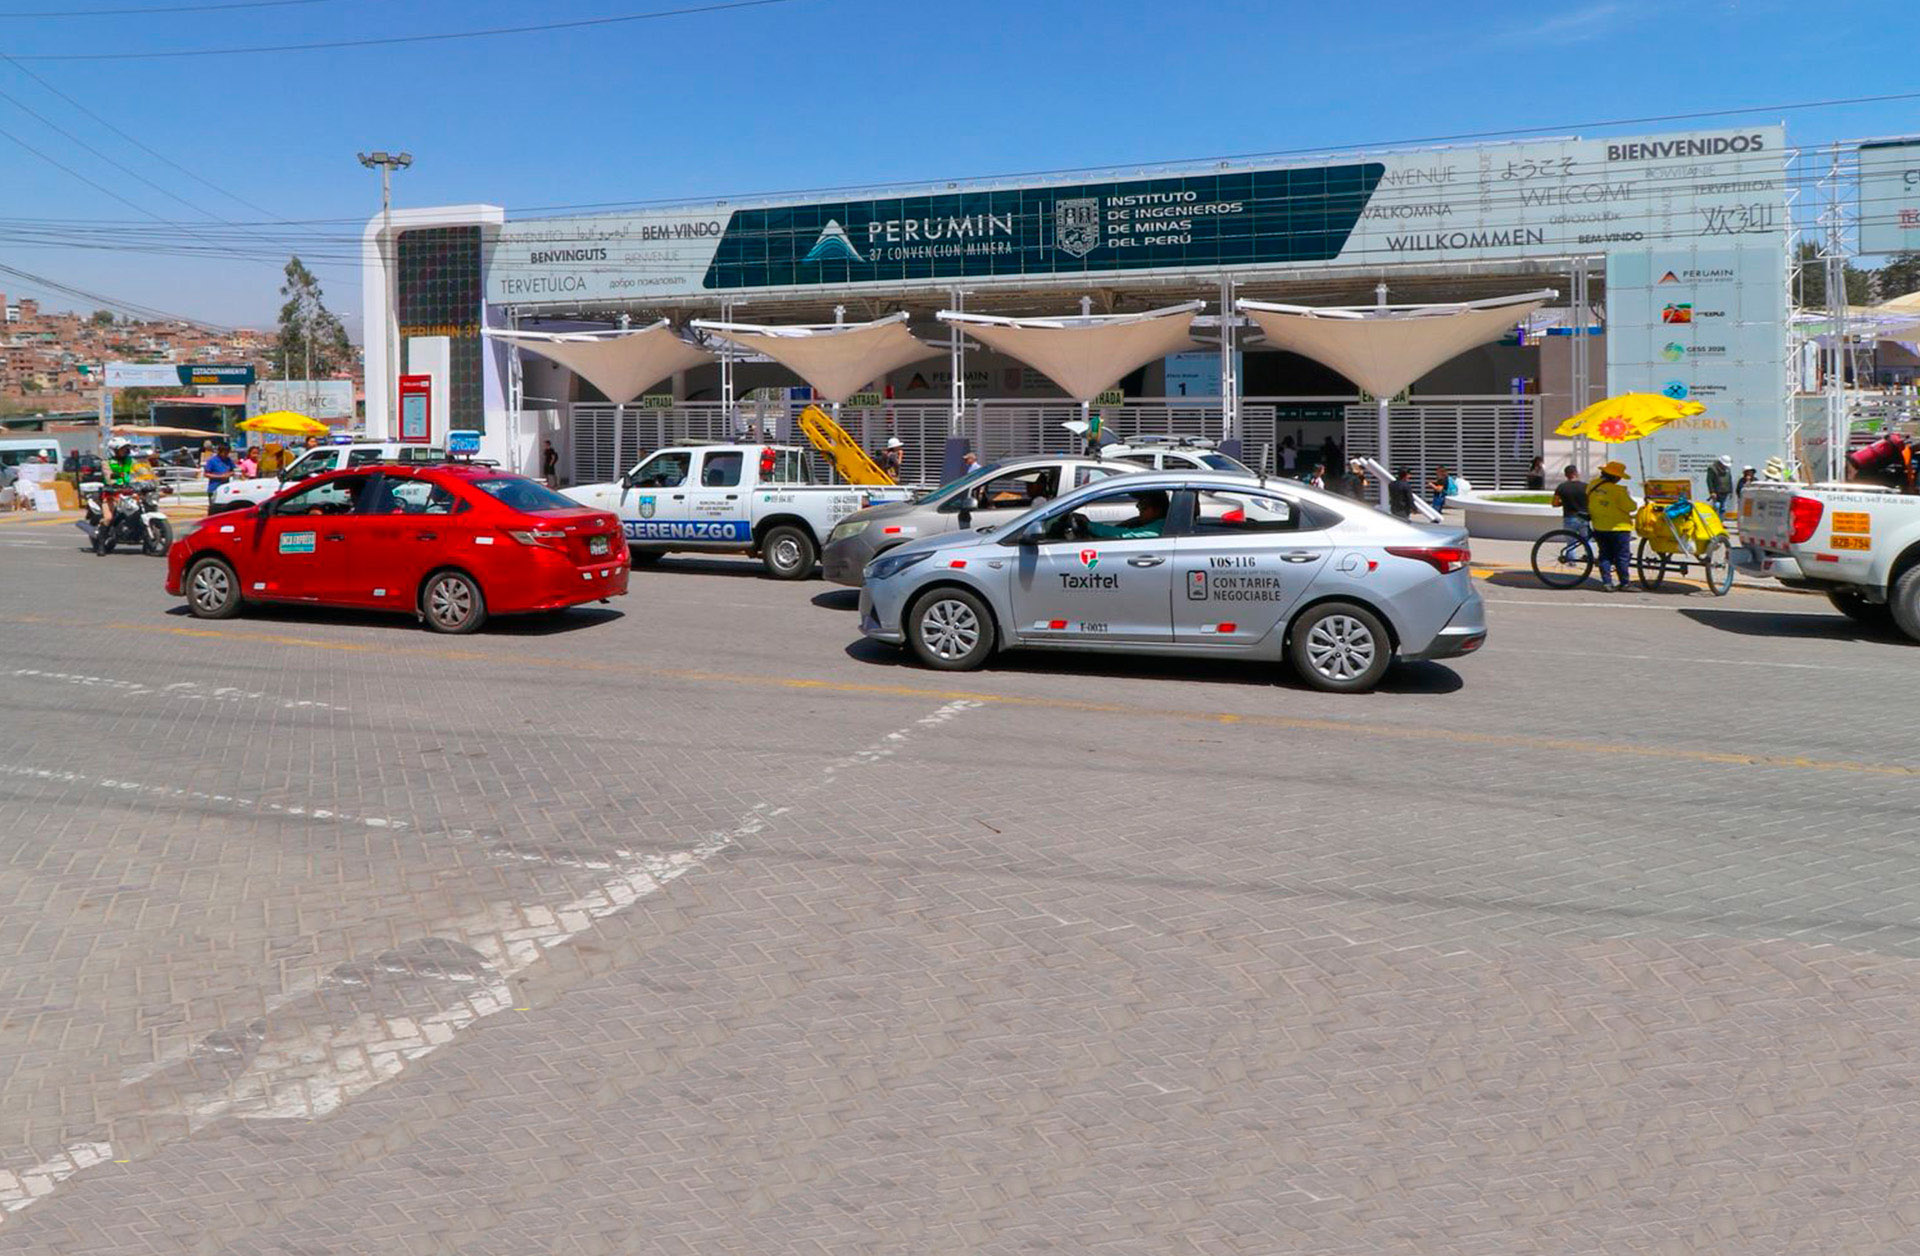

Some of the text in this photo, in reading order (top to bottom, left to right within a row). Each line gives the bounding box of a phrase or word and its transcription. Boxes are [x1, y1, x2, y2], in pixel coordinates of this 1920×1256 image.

[1608, 134, 1763, 161] BIENVENIDOS
[1501, 157, 1578, 180] ようこそ
[1107, 191, 1197, 207] INSTITUTO
[1520, 182, 1638, 207] WELCOME
[1108, 202, 1243, 220] DE INGENIEROS
[868, 212, 1012, 243] PERUMIN
[1108, 220, 1192, 234] DE MINAS
[1698, 203, 1774, 236] 欢迎
[642, 221, 720, 240] BEM-VINDO
[1578, 232, 1644, 244] BEM-VINDO
[1108, 232, 1192, 248] DEL PERÚ
[1386, 228, 1544, 251] WILLKOMMEN
[531, 248, 607, 264] BENVINGUTS
[869, 241, 1012, 261] 37 CONVENCION MINERA
[1683, 270, 1733, 278] PERUMIN
[501, 276, 587, 294] TERVETULOA
[609, 277, 635, 289] добро
[1179, 382, 1186, 396] 1
[645, 396, 673, 408] ENTRADA
[848, 395, 880, 406] ENTRADA
[623, 522, 737, 539] SERENAZGO
[1059, 573, 1119, 589] Taxitel
[1213, 577, 1280, 588] CON TARIFA
[1214, 590, 1281, 601] NEGOCIABLE
